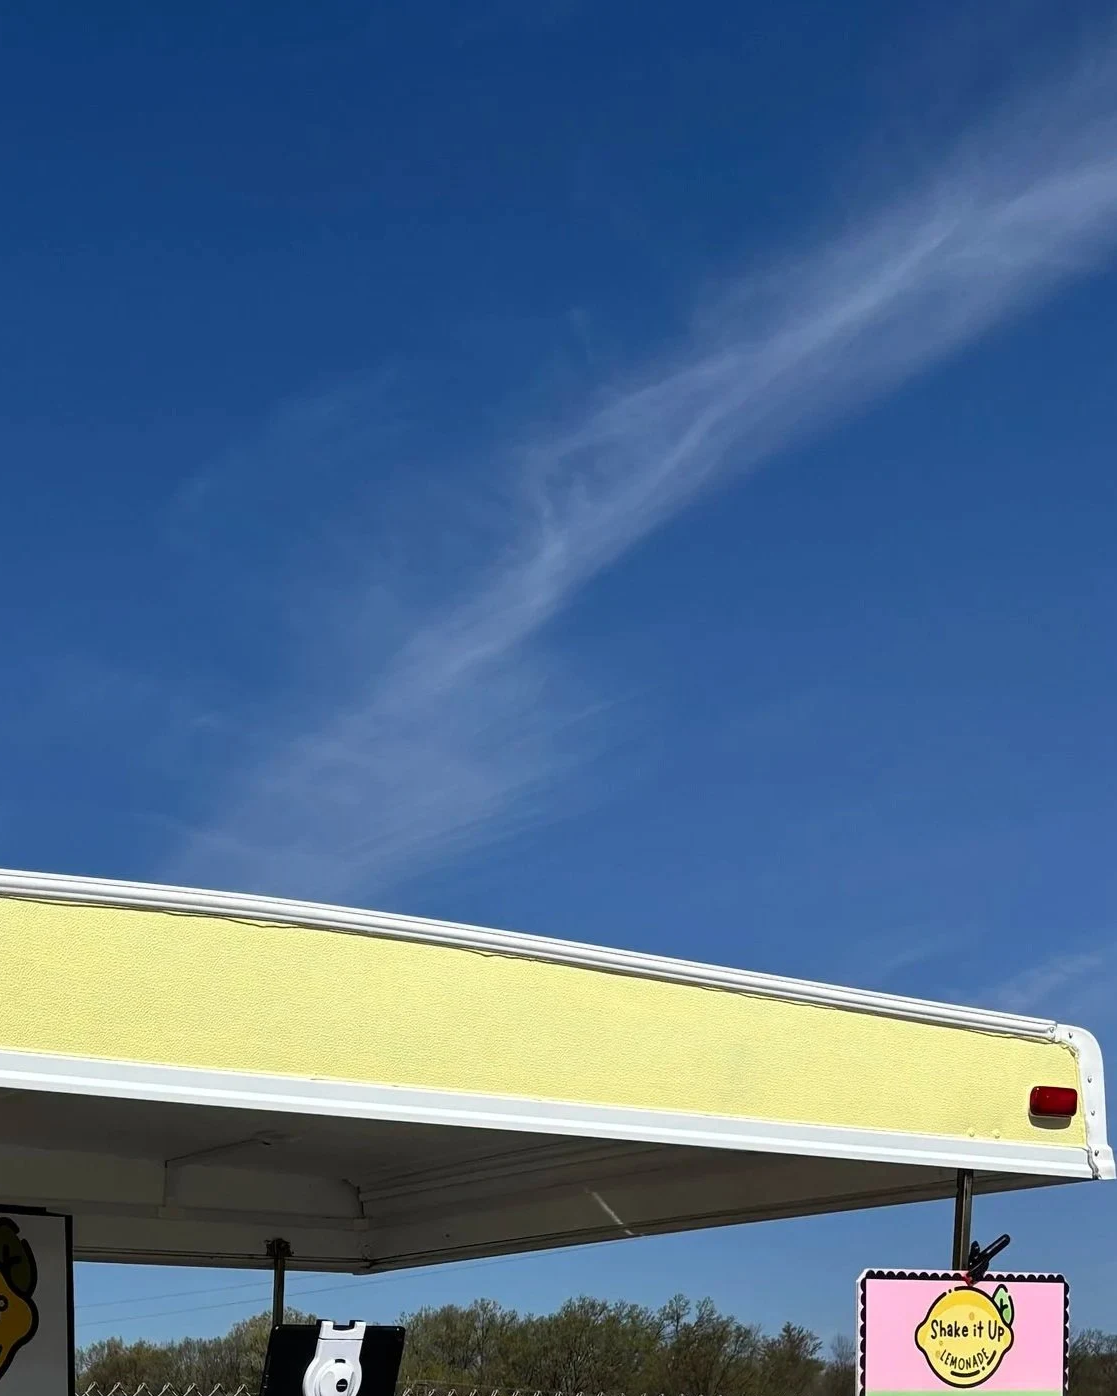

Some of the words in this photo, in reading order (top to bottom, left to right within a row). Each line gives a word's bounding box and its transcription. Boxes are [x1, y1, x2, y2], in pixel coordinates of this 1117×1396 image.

[930, 1319, 969, 1340] Shake
[972, 1321, 983, 1338] it
[988, 1320, 1005, 1342] Up
[939, 1347, 990, 1371] LEMONADE
